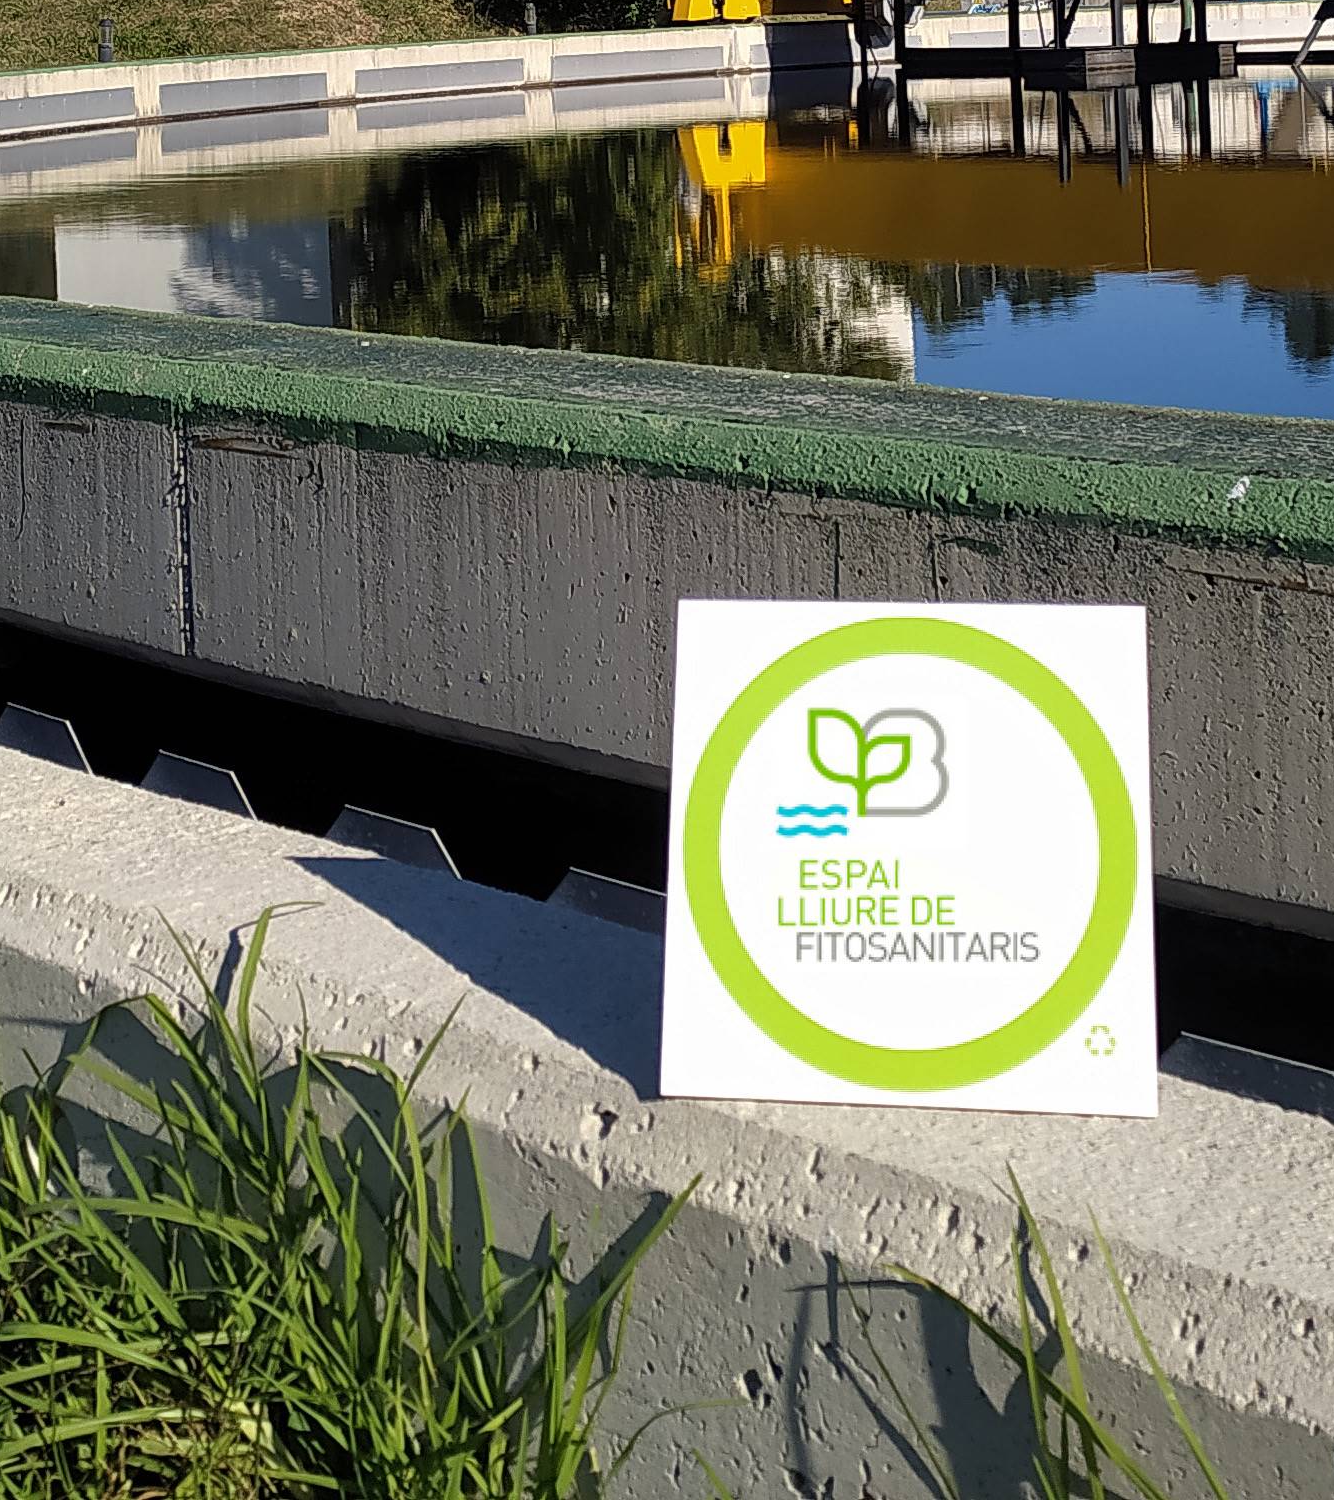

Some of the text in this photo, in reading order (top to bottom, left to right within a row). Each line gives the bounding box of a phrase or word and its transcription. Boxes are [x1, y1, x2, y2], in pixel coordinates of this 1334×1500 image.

[799, 858, 899, 890] ESPAI
[778, 895, 955, 926] LLIURE DE
[796, 931, 1040, 963] FITOSANITARIS
